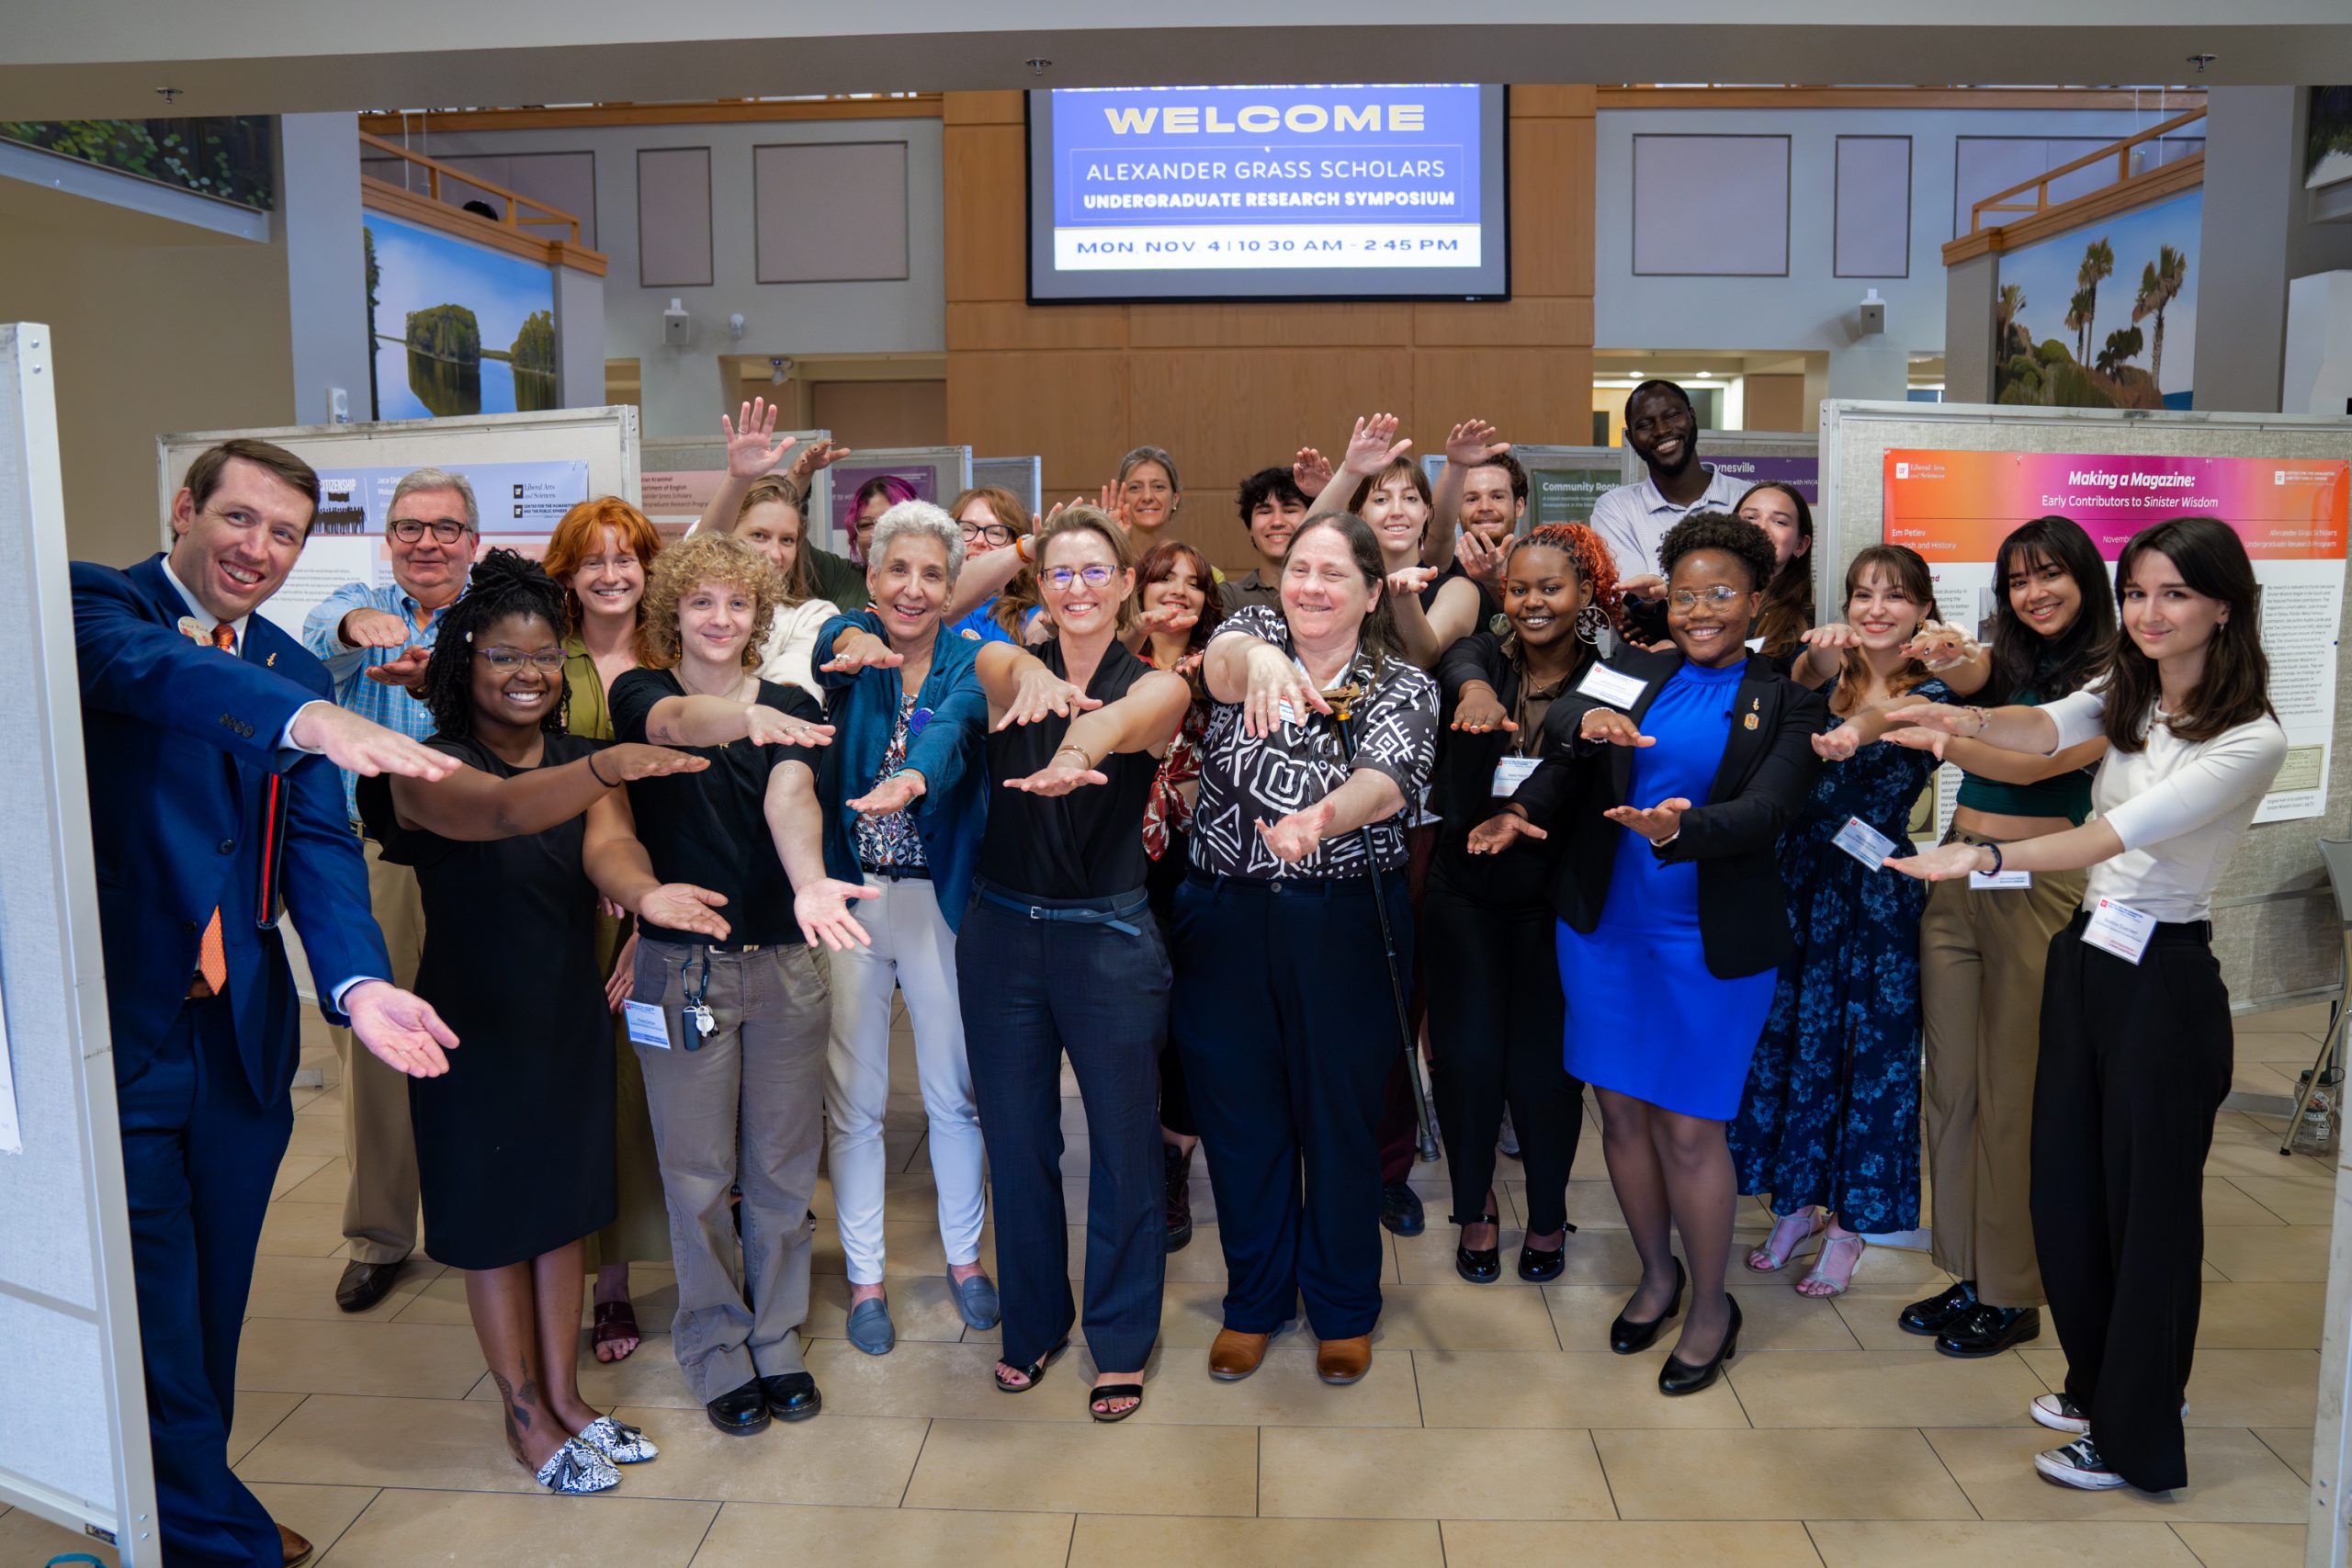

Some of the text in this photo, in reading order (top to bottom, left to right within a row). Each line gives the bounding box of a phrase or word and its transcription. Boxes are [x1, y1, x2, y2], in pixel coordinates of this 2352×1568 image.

[1104, 105, 1425, 134] WELCOME
[1087, 160, 1445, 181] ALEXANDER GRASS SCHOLARS
[1084, 190, 1454, 209] UNDERGRADUATE RESEARCH SYMPOSIUM
[1207, 241, 1221, 252] 4
[1304, 240, 1342, 251] AM
[1420, 239, 1458, 250] PM
[1543, 481, 1594, 492] Community
[2069, 470, 2196, 490] Making a Magazine:
[2042, 495, 2218, 509] Early Contributors to Sinister Wisdom
[2103, 536, 2131, 544] Novemb
